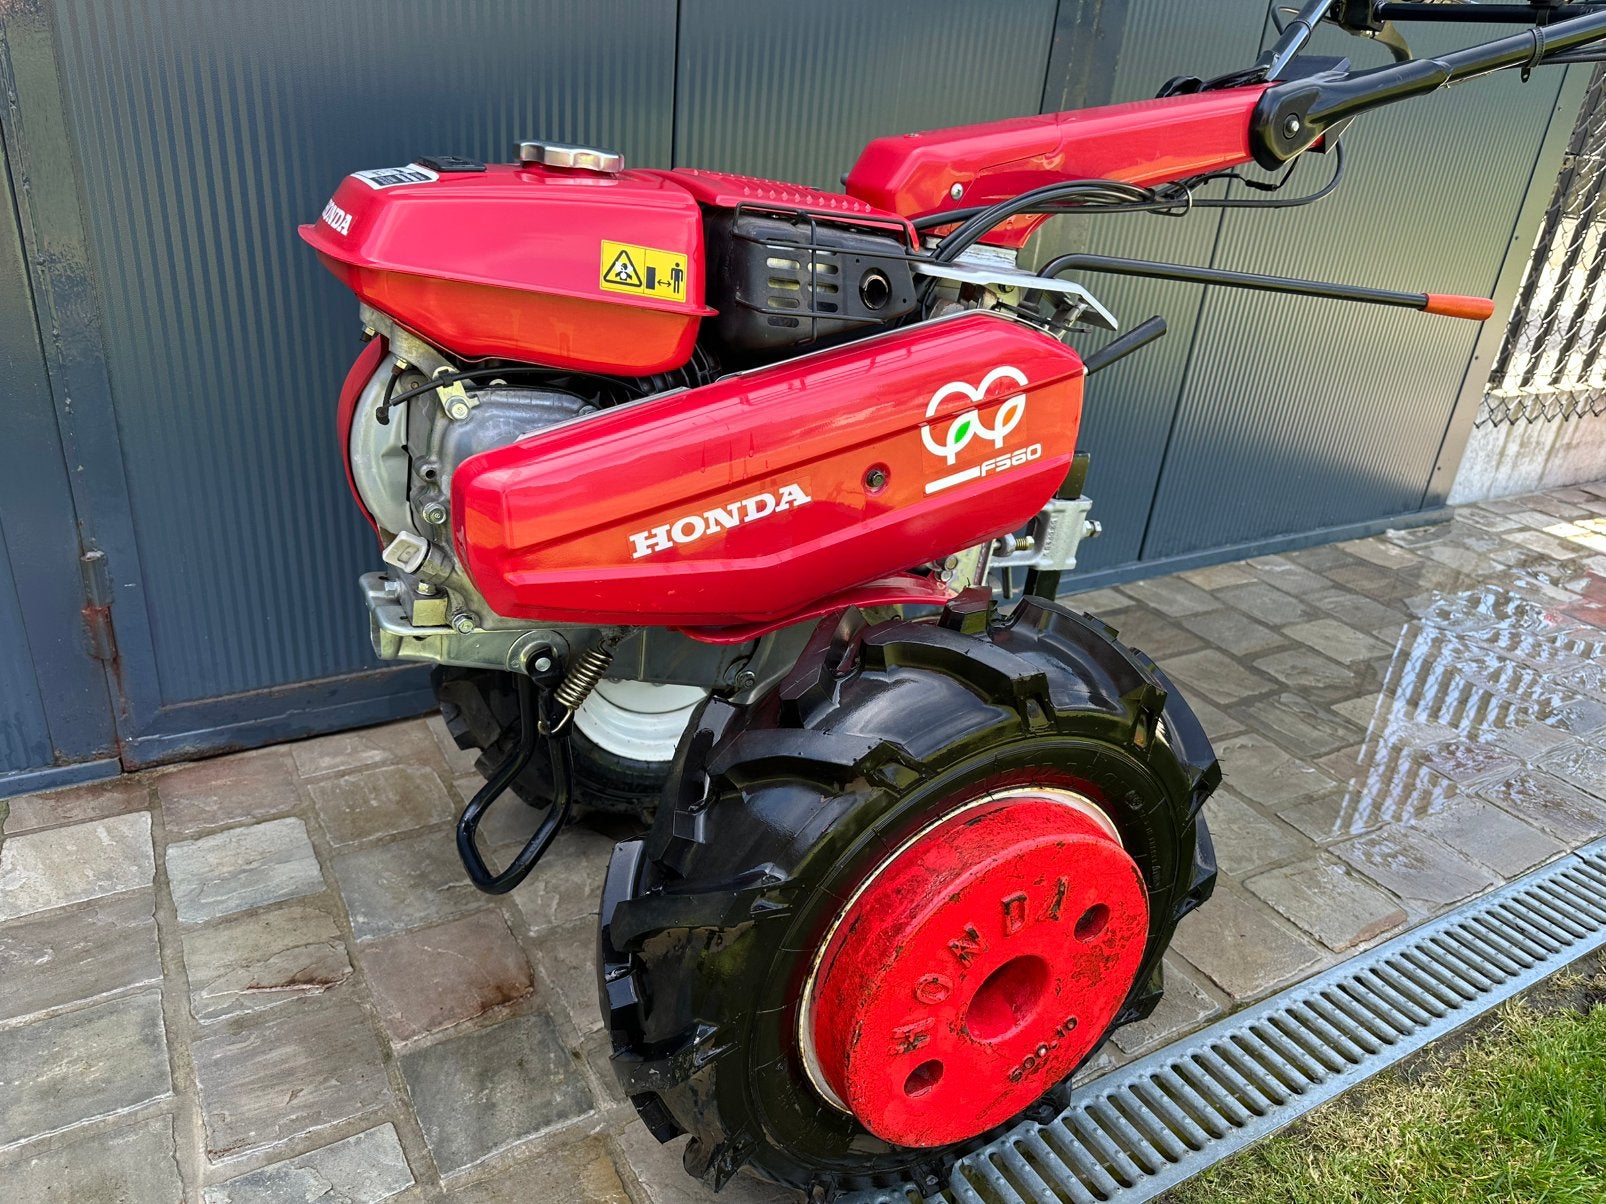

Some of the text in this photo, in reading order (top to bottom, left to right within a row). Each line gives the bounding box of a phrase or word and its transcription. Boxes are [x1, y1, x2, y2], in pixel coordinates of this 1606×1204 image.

[322, 198, 353, 236] ONDA
[981, 443, 1042, 477] F560
[629, 483, 812, 559] HONDA
[889, 875, 1070, 1056] HONDA
